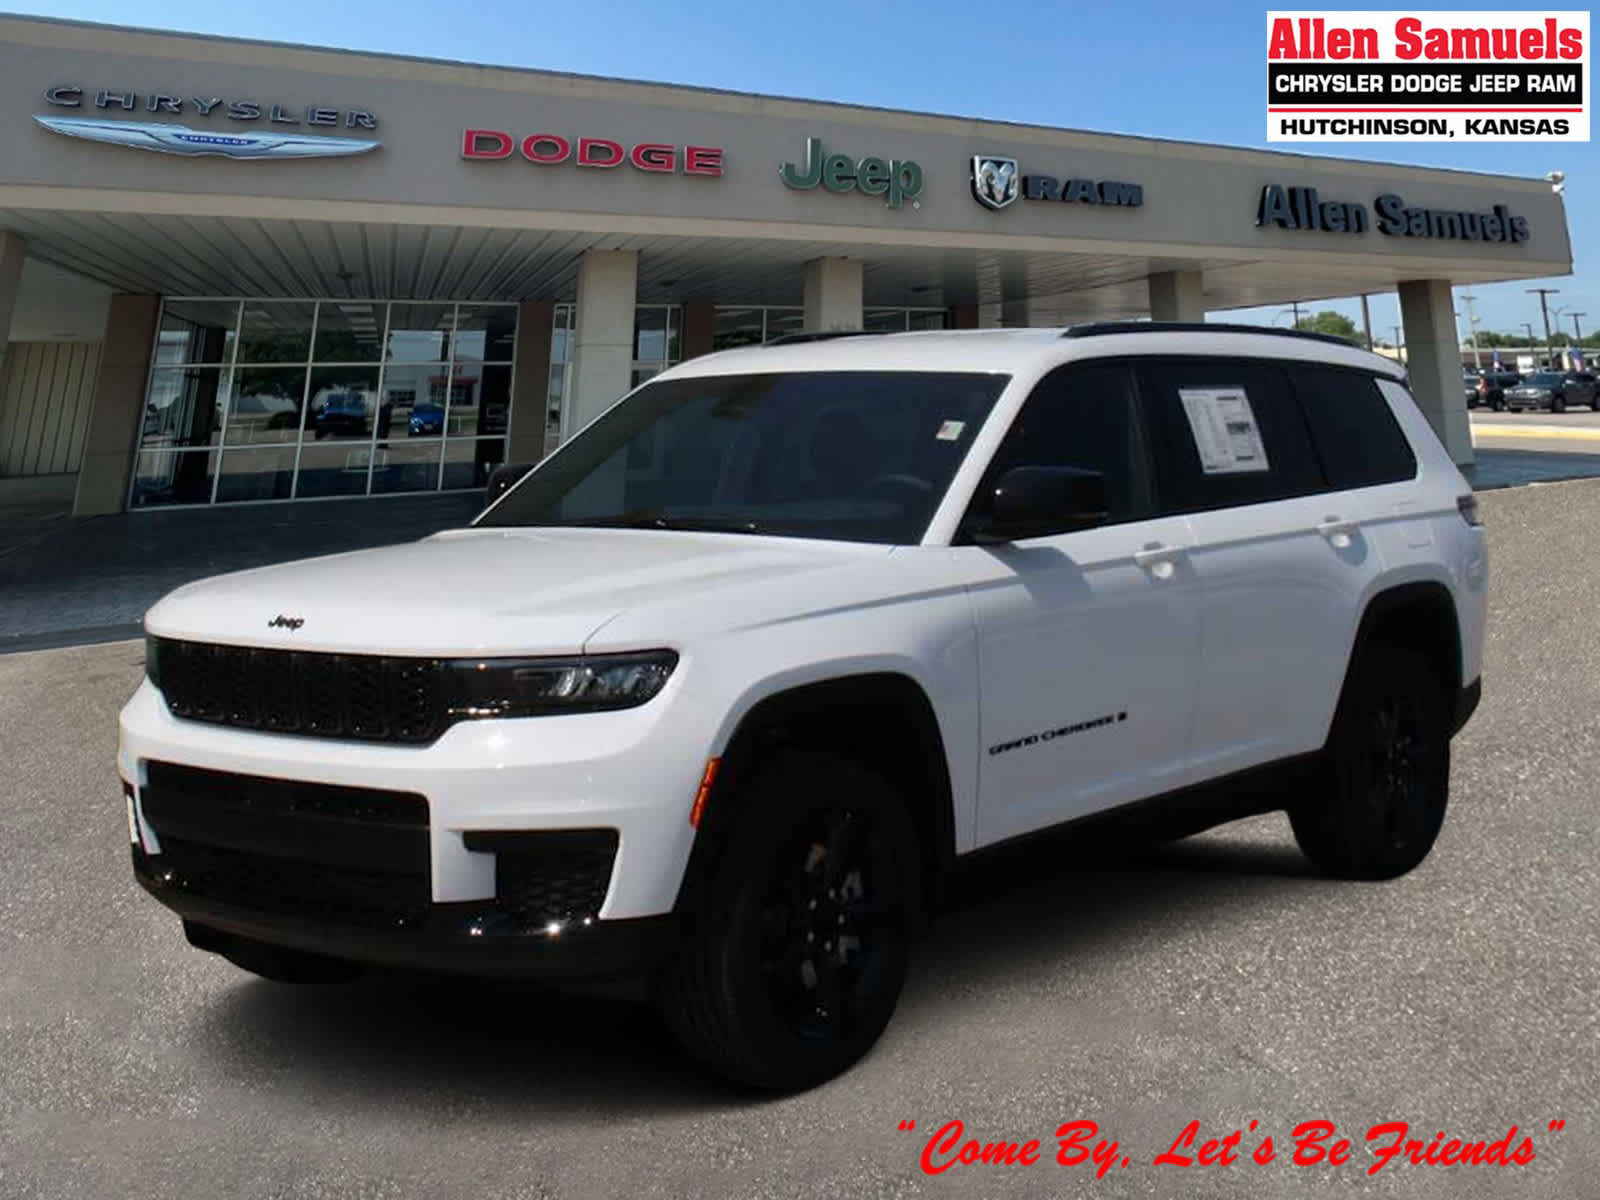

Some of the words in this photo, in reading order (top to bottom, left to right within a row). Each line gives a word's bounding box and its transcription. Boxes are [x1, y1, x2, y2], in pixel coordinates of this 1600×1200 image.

[43, 86, 378, 129] CHRYSLER
[461, 128, 724, 176] DODGE
[779, 136, 923, 209] Jeep
[1022, 175, 1144, 208] RAM
[1255, 184, 1369, 233] Allen
[1373, 193, 1530, 243] Samuels
